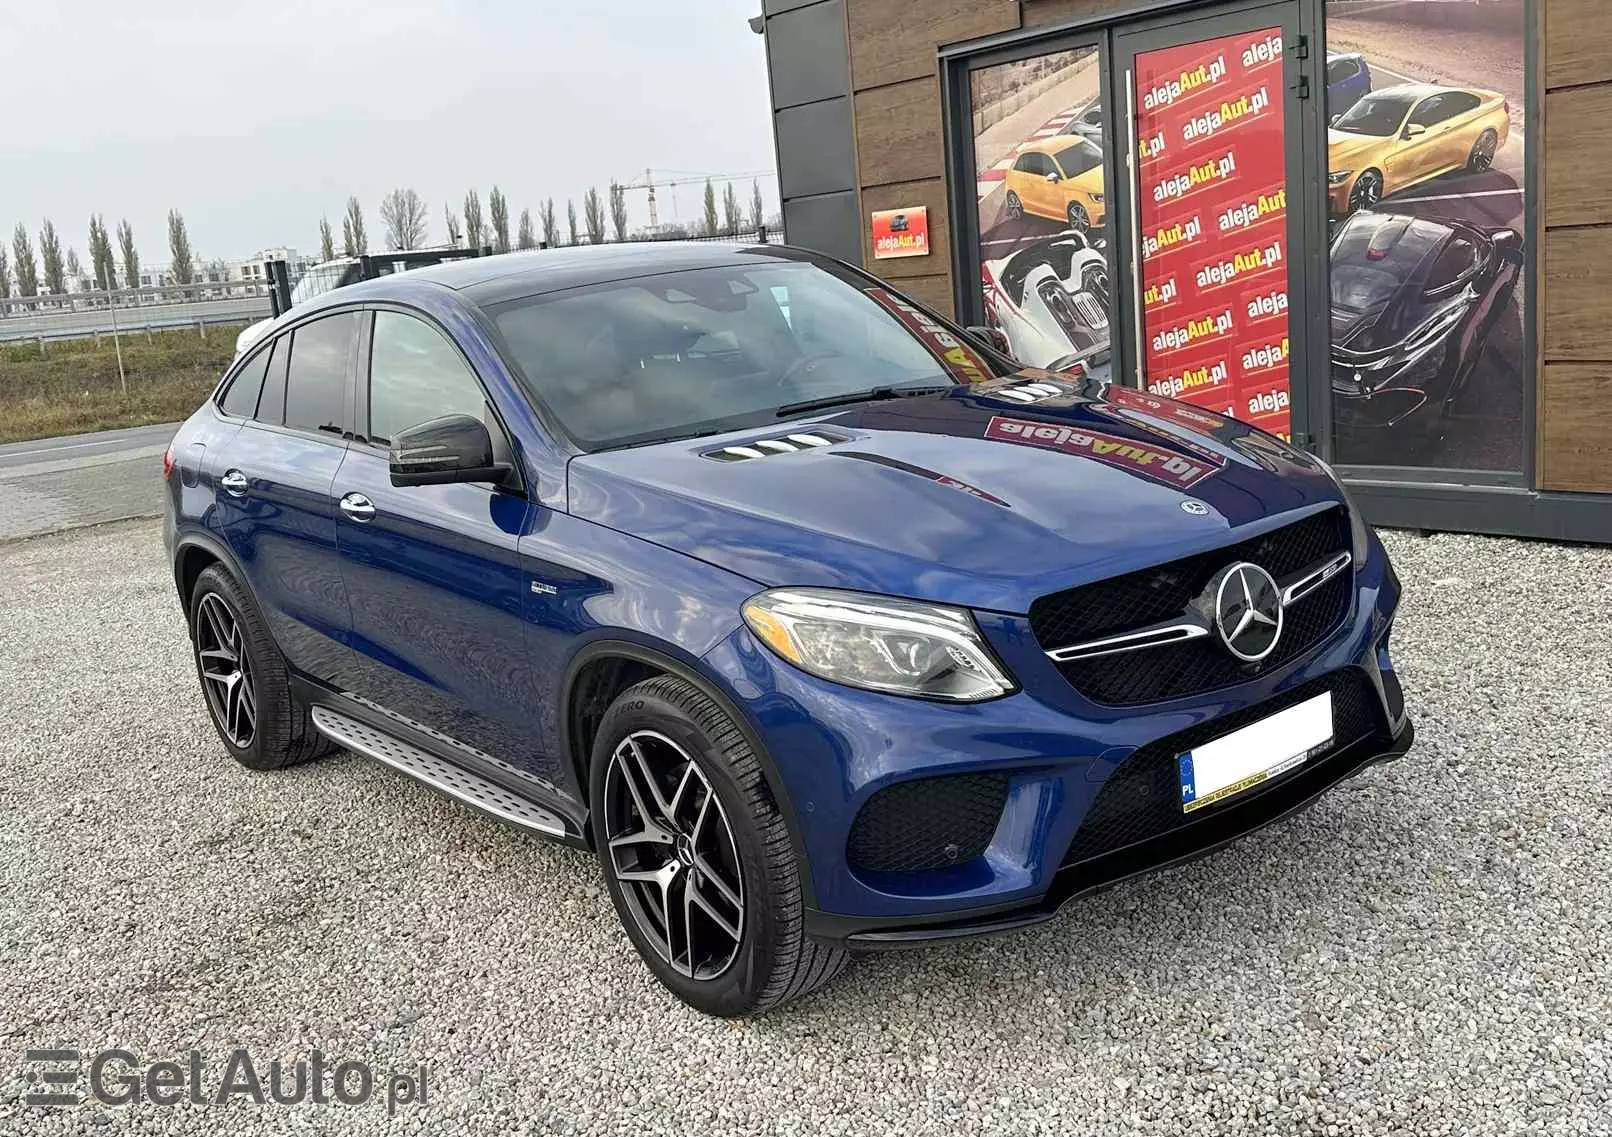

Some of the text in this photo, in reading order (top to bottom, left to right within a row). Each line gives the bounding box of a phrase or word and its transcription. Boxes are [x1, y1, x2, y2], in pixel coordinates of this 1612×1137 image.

[1242, 36, 1283, 67] aleja
[1144, 56, 1226, 110] alejaAut.pl
[1183, 87, 1269, 140] alejaAut.pl
[1153, 152, 1235, 201] alejaAut.pl
[877, 232, 925, 251] alejaAut.pl
[1142, 216, 1200, 258] jaAut.pl
[1197, 241, 1282, 288] alejaAut.pl
[1247, 292, 1288, 318] aleja
[1152, 310, 1233, 352] alejaAut.pl
[1148, 361, 1228, 398] alejaAut.pl
[1248, 389, 1290, 413] aleja
[1182, 783, 1194, 796] PL
